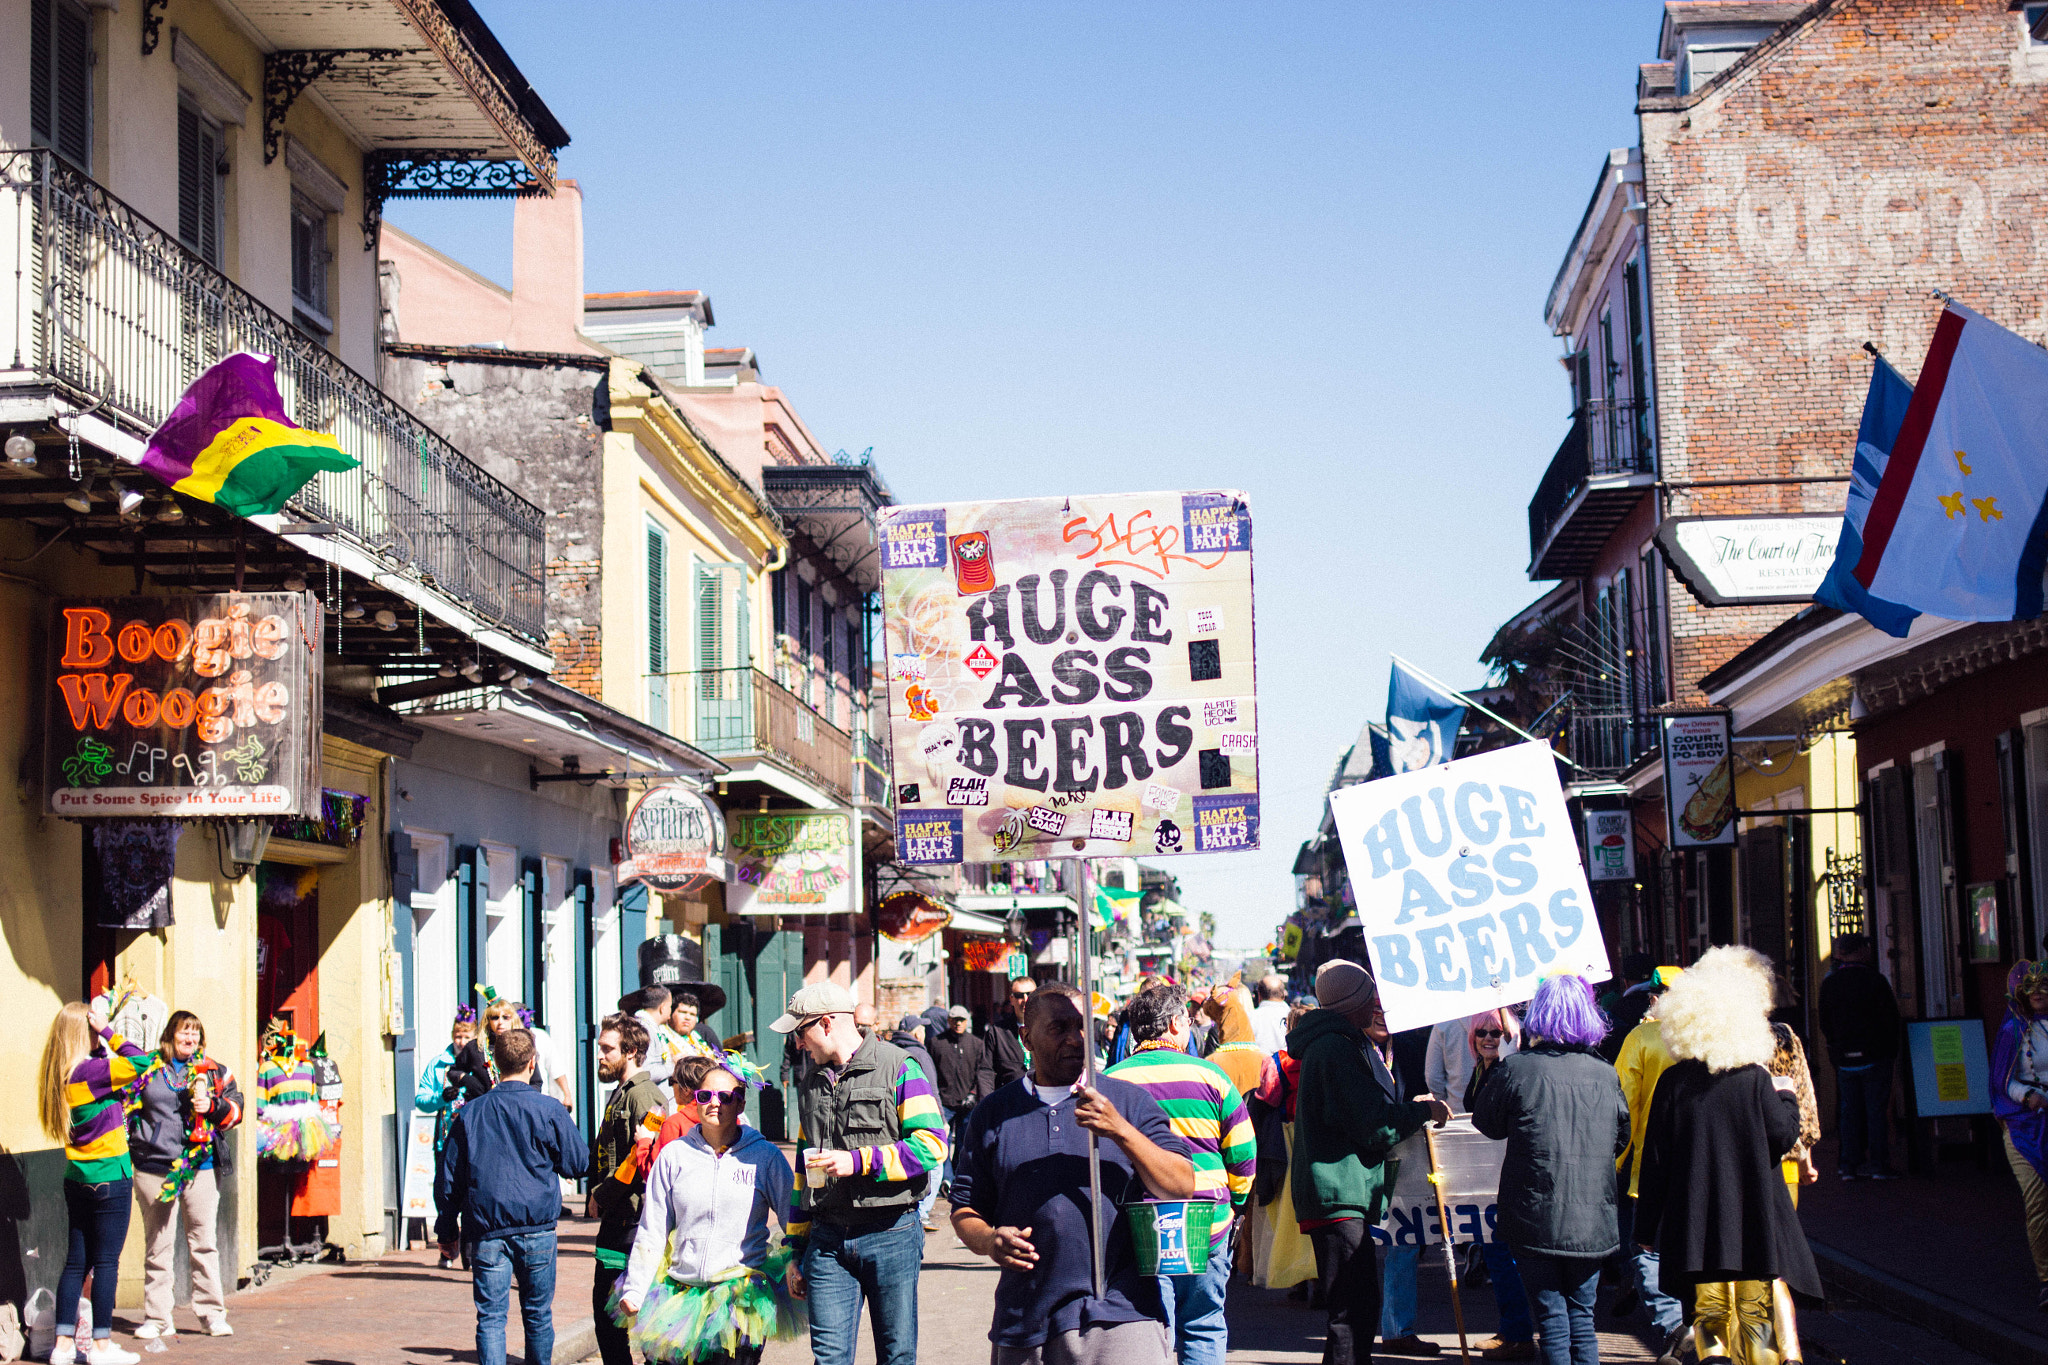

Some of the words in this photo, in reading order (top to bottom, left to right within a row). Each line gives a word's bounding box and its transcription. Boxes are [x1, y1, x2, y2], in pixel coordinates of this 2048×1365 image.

[1217, 515, 1238, 523] GRAS
[887, 522, 934, 537] HAPPY
[1192, 522, 1239, 538] LET'S
[888, 534, 914, 542] MARDI
[1193, 534, 1241, 550] PARTY.
[888, 538, 936, 555] LET'S
[1711, 535, 1745, 567] The
[1750, 535, 1783, 561] Court
[1787, 538, 1803, 563] of
[890, 551, 938, 566] PARTY.
[966, 568, 1172, 650] HUGE
[60, 602, 289, 677] Boogie
[983, 646, 1153, 709] ASS
[57, 669, 289, 743] Woogie
[1222, 734, 1256, 748] CRASH
[1673, 734, 1720, 743] COURT
[954, 705, 1193, 793] BEERS
[1672, 742, 1723, 751] TAVERN
[1672, 750, 1724, 759] PO-BOY
[950, 777, 987, 790] BLAH
[60, 793, 88, 805] Put
[92, 793, 135, 804] Some
[139, 792, 181, 806] Spice
[187, 793, 202, 804] In
[208, 793, 245, 804] Your
[251, 792, 281, 803] Life
[1199, 806, 1246, 819] HAPPY
[638, 806, 704, 841] SPIRITS
[732, 814, 853, 847] JESTER
[905, 821, 951, 834] HAPPY
[1029, 818, 1062, 835] CRASH
[1201, 821, 1247, 839] LET'S
[1363, 781, 1545, 879] HUGE
[905, 831, 930, 839] MARDI
[932, 829, 952, 837] GRAS
[1202, 834, 1249, 849] PARTY.
[763, 844, 793, 857] MARDI
[906, 836, 953, 851] LET'S
[907, 848, 955, 861] PARTY.
[657, 874, 670, 882] TO
[671, 874, 687, 882] GO
[737, 866, 850, 891] DAIQUIRIS
[1394, 842, 1538, 925] ASS
[758, 893, 786, 903] AND
[1371, 888, 1584, 992] BEERS
